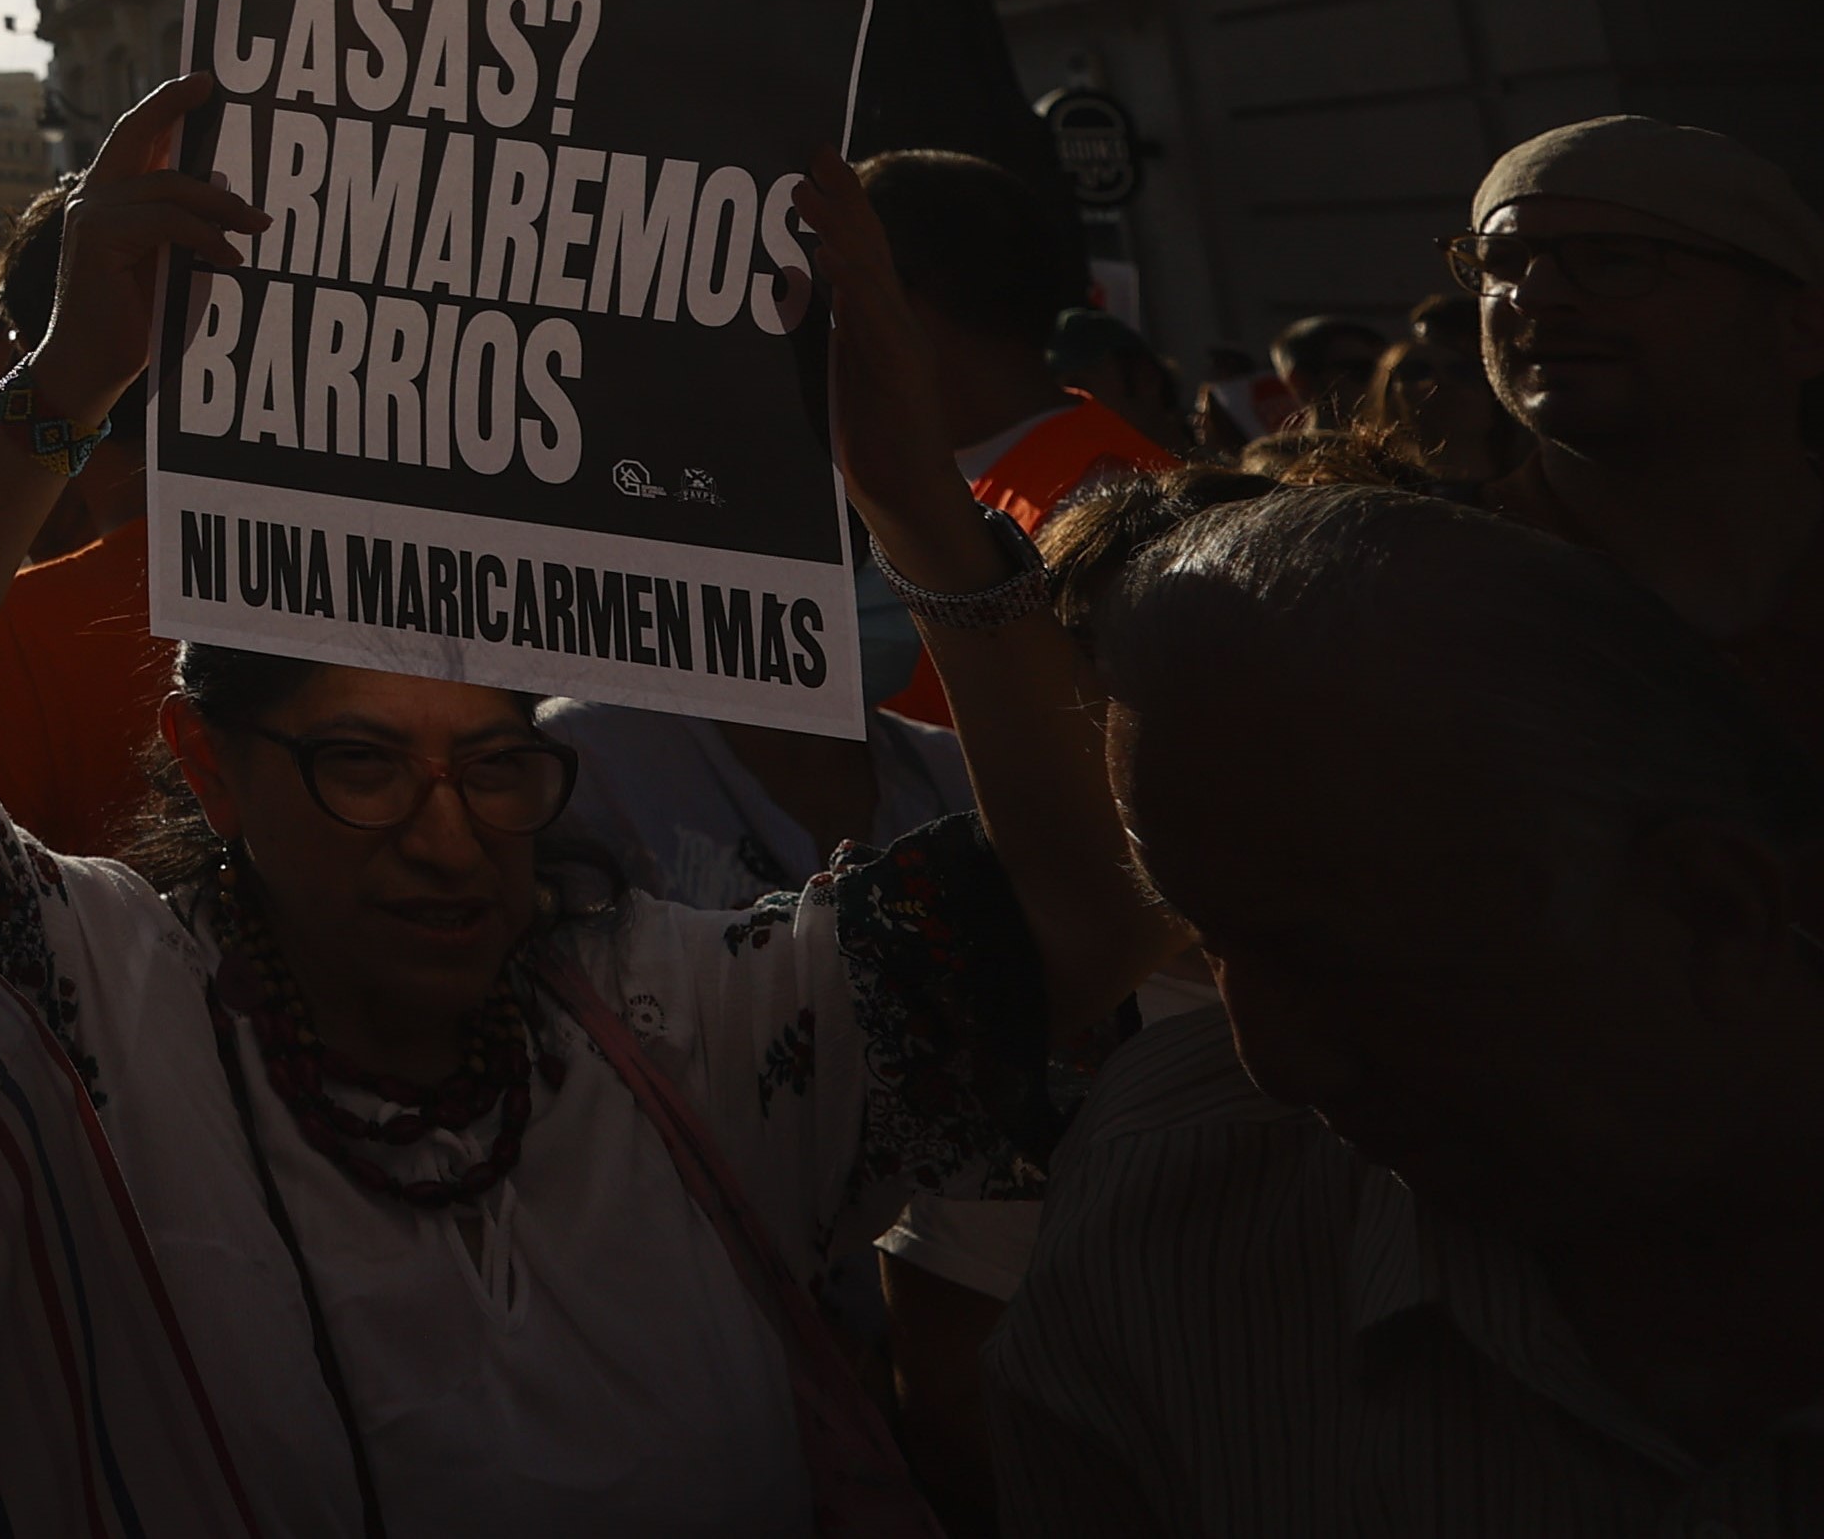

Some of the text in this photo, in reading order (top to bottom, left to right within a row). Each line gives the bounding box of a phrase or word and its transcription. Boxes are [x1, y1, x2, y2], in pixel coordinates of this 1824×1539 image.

[196, 102, 818, 336] ARMAREMOS
[180, 271, 583, 485] BARRIOS
[180, 510, 827, 689] NI UNA MARICARMEN MÁS
